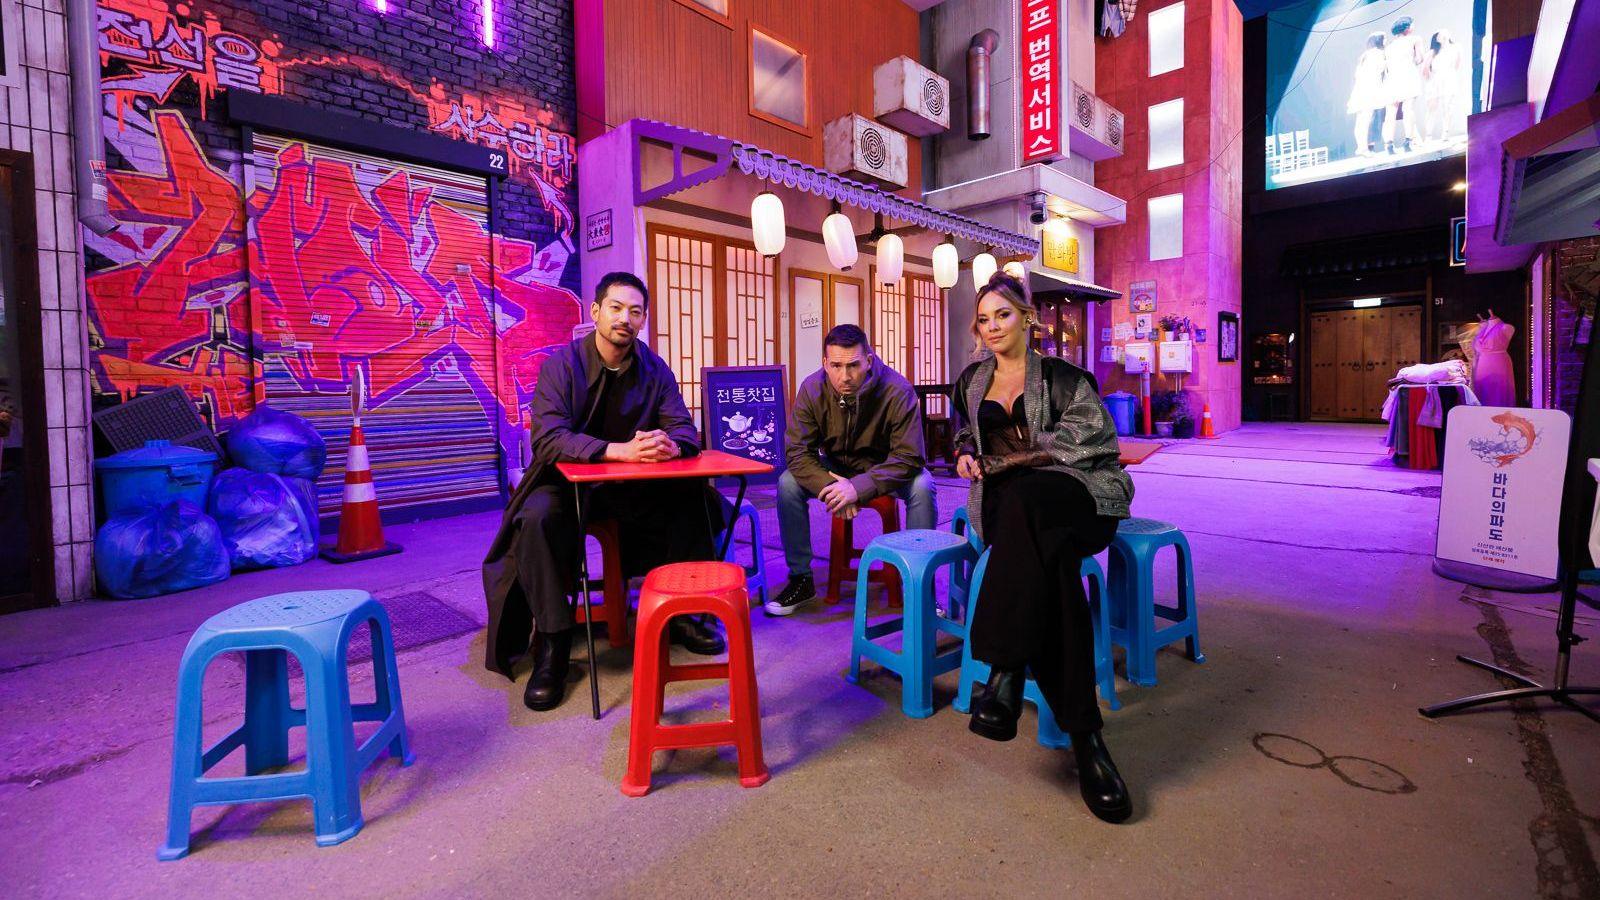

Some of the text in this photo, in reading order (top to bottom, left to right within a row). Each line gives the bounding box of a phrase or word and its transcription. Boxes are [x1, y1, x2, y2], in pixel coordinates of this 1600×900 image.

[1027, 0, 1051, 32] 프
[96, 7, 262, 93] 전선을
[428, 103, 574, 178] 사수하라
[489, 153, 504, 170] 22
[1435, 297, 1444, 305] 51
[717, 387, 775, 404] 전통찻집
